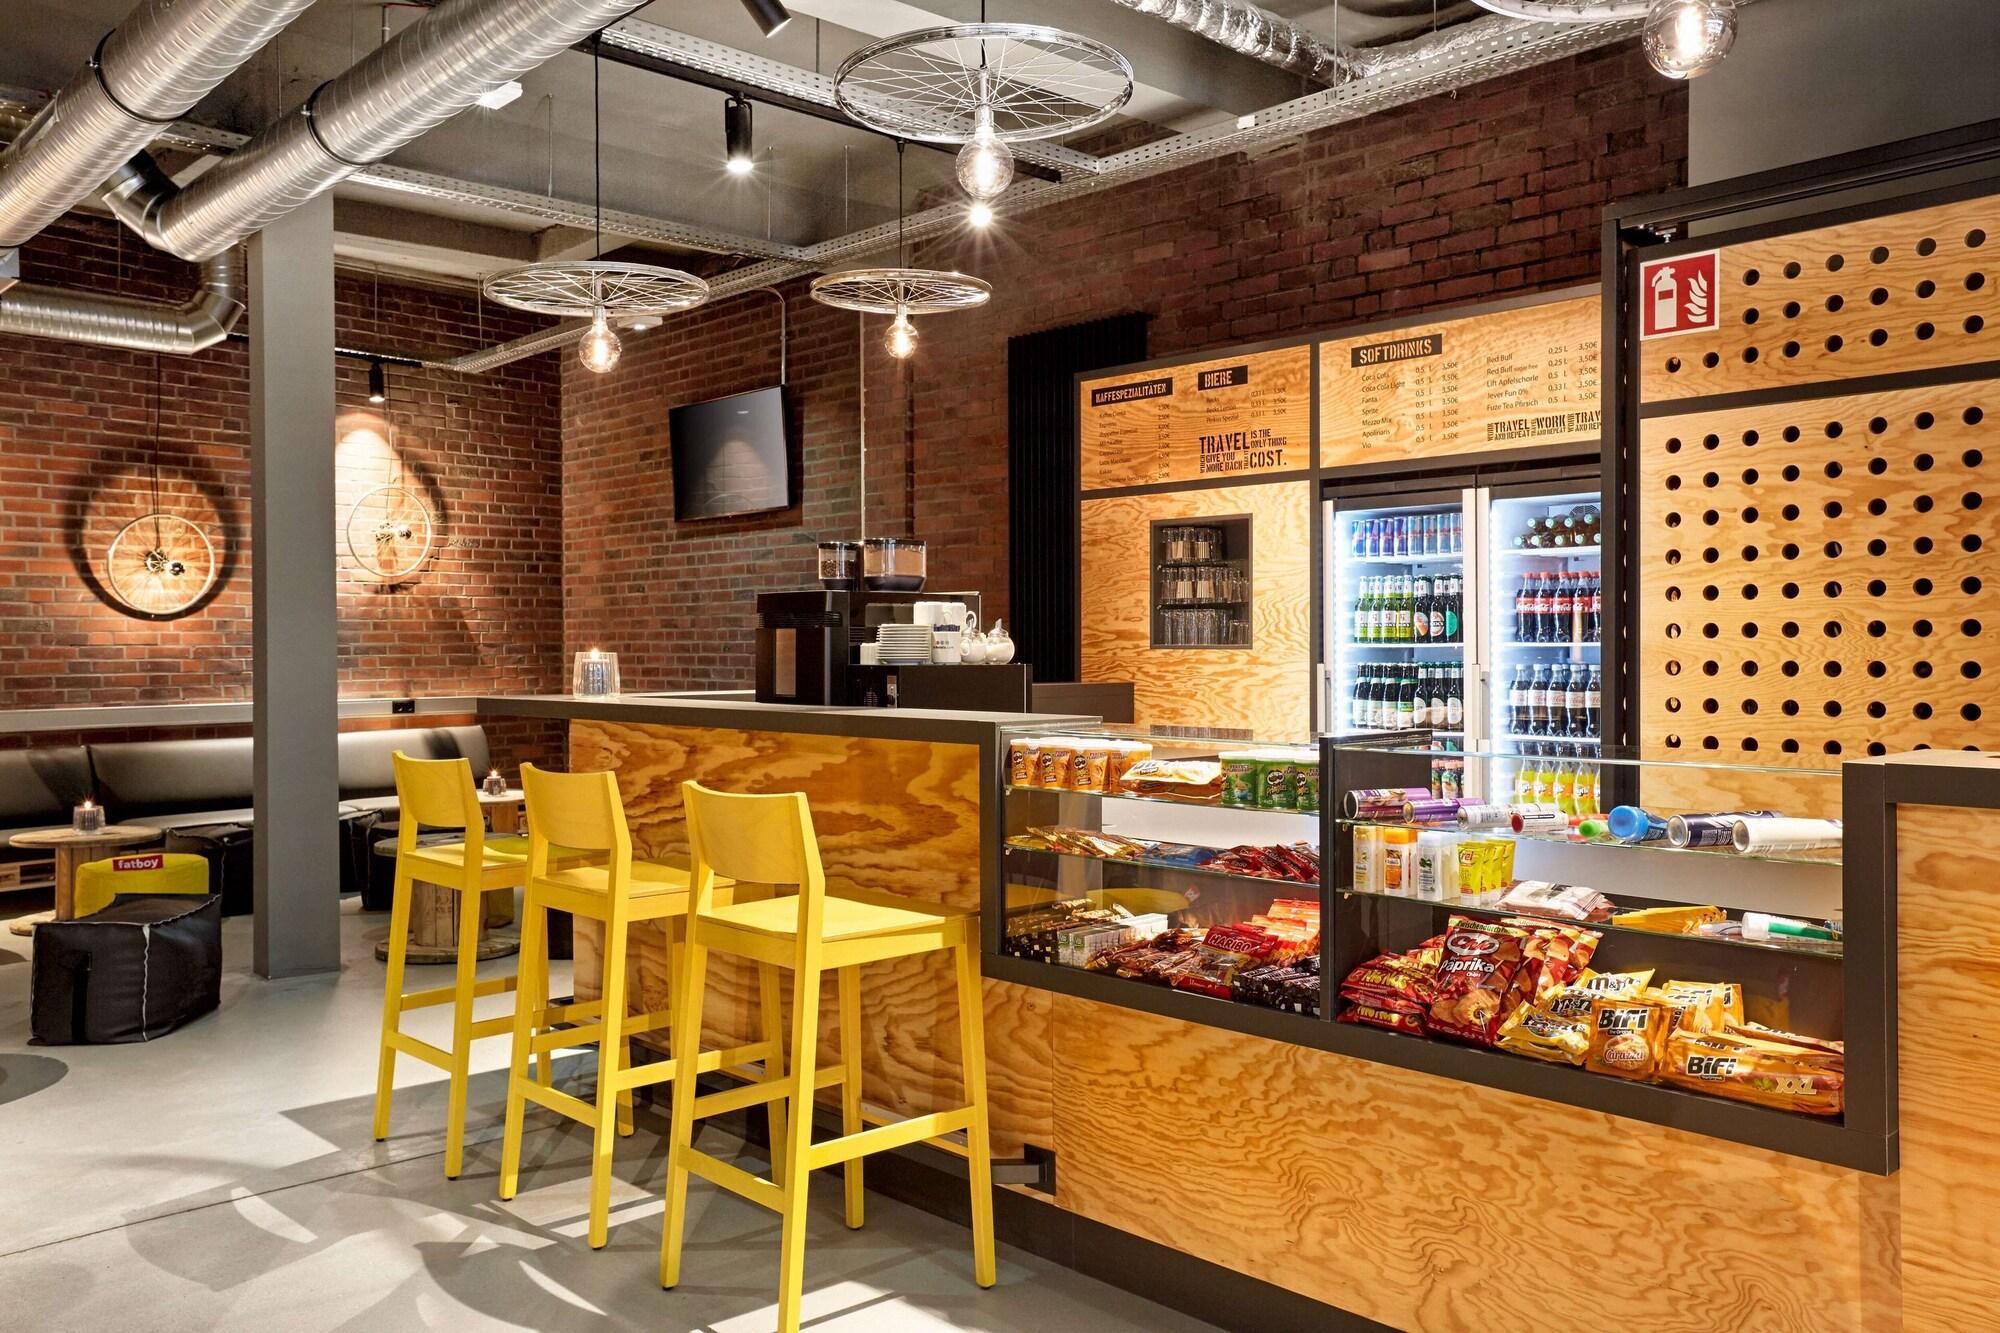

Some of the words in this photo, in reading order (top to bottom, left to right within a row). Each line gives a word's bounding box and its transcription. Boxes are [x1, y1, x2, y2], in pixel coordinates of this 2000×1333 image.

[1360, 338, 1432, 364] SOFTDRINKS
[1579, 341, 1597, 350] 3,50€
[1579, 354, 1597, 362] 3,50€
[1204, 370, 1232, 388] BIERE
[1498, 375, 1539, 386] Apfelschorle
[1579, 366, 1597, 375] 3,50€
[1579, 380, 1597, 388] 3,50€
[1579, 392, 1597, 400] 3,50€
[1494, 419, 1530, 432] TRAVEL
[1536, 415, 1565, 429] WORK
[1575, 424, 1587, 432] AND
[1251, 430, 1257, 439] IS
[1259, 429, 1271, 438] THE
[1507, 430, 1530, 439] REPEAT
[1199, 432, 1250, 454] TRAVEL
[1251, 439, 1266, 448] ONLY
[1268, 437, 1287, 447] THING
[1206, 453, 1220, 463] GIVE
[1222, 452, 1235, 461] YOU
[1250, 449, 1287, 468] COST.
[1206, 463, 1223, 472] MORE
[1225, 461, 1242, 471] BACK
[118, 859, 158, 869] fatboy
[1208, 934, 1252, 953] HARIBO
[1439, 958, 1495, 979] Paprika
[1599, 1009, 1648, 1029] BiFi
[1688, 1056, 1737, 1074] BiFi
[1776, 1077, 1817, 1094] XXL
